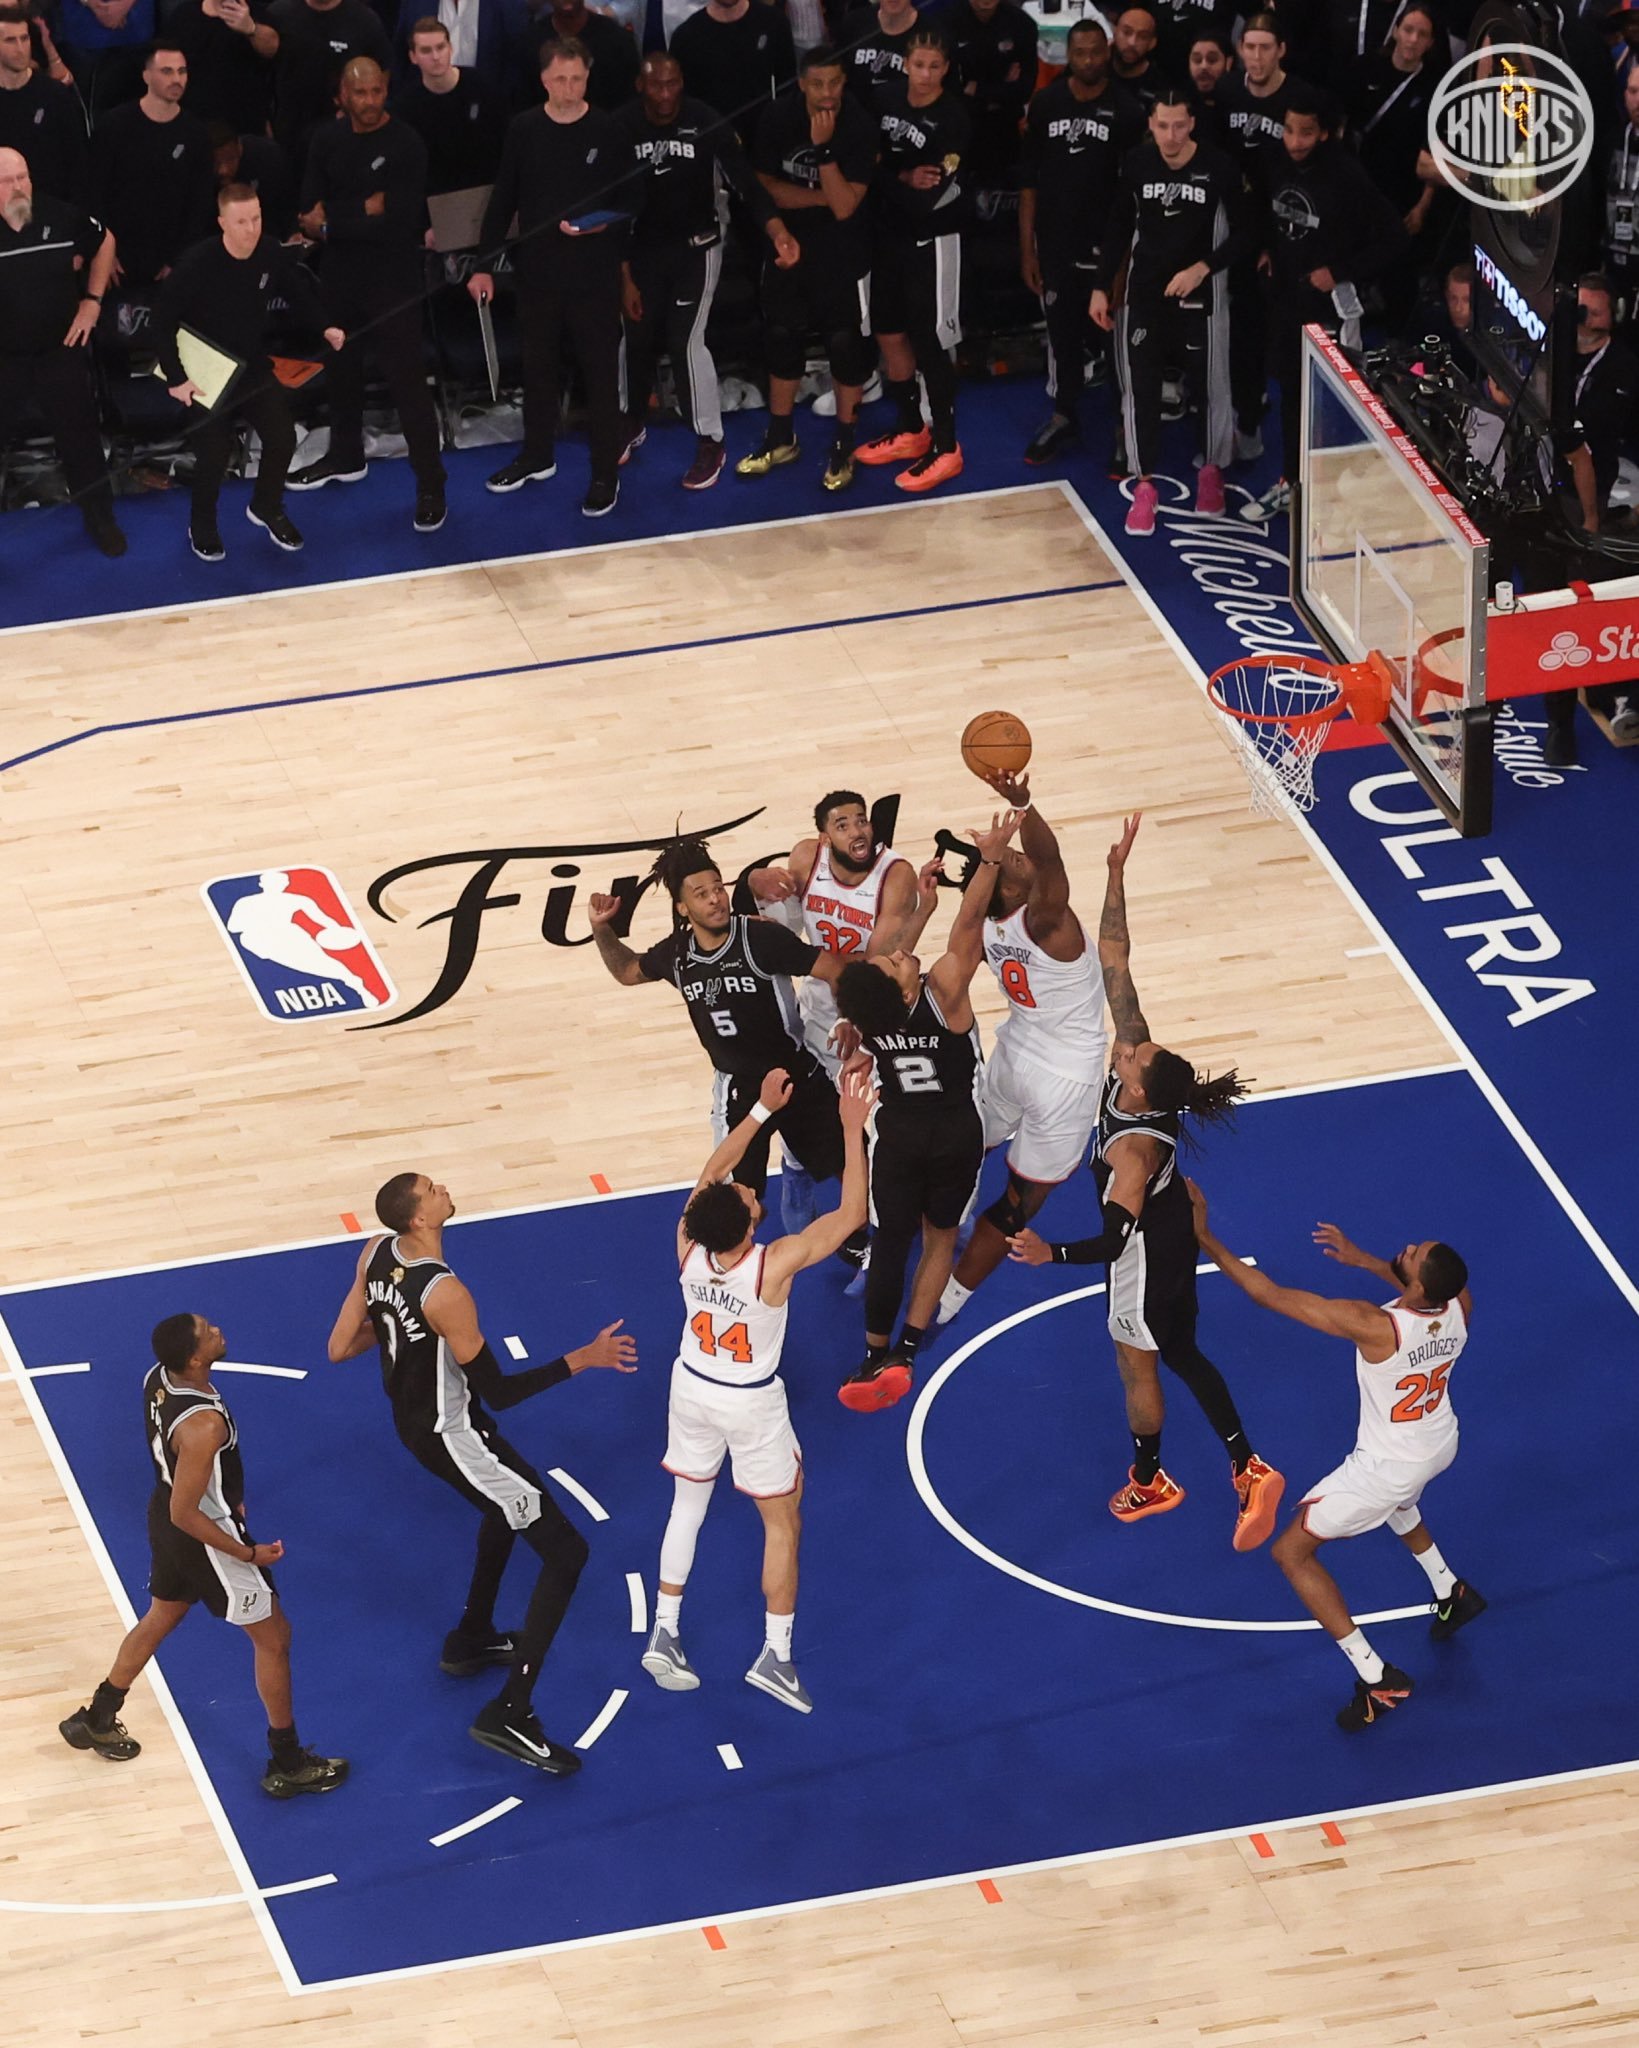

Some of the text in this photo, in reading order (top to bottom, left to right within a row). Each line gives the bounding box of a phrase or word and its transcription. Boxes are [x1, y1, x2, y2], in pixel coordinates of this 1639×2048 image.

[855, 48, 910, 74] SPUR
[881, 115, 926, 149] SPURS
[1048, 118, 1110, 143] SPURS
[1230, 112, 1286, 139] SPURS
[1143, 182, 1206, 206] SPURS
[1495, 267, 1547, 350] TISSOT
[806, 894, 874, 932] NEW YORK
[1348, 771, 1596, 1028] ULTRA
[815, 919, 862, 953] 32
[274, 982, 346, 1013] NBA
[683, 976, 757, 1007] SPURS
[1001, 959, 1036, 1008] 8
[710, 1009, 738, 1037] 5
[872, 1033, 940, 1051] HARPER
[892, 1055, 943, 1093] 2
[364, 1280, 427, 1343] MBANYAMA
[690, 1284, 748, 1317] SHAMET
[690, 1310, 753, 1364] 44
[1407, 1337, 1458, 1368] BRIDGES
[1390, 1357, 1455, 1423] 25
